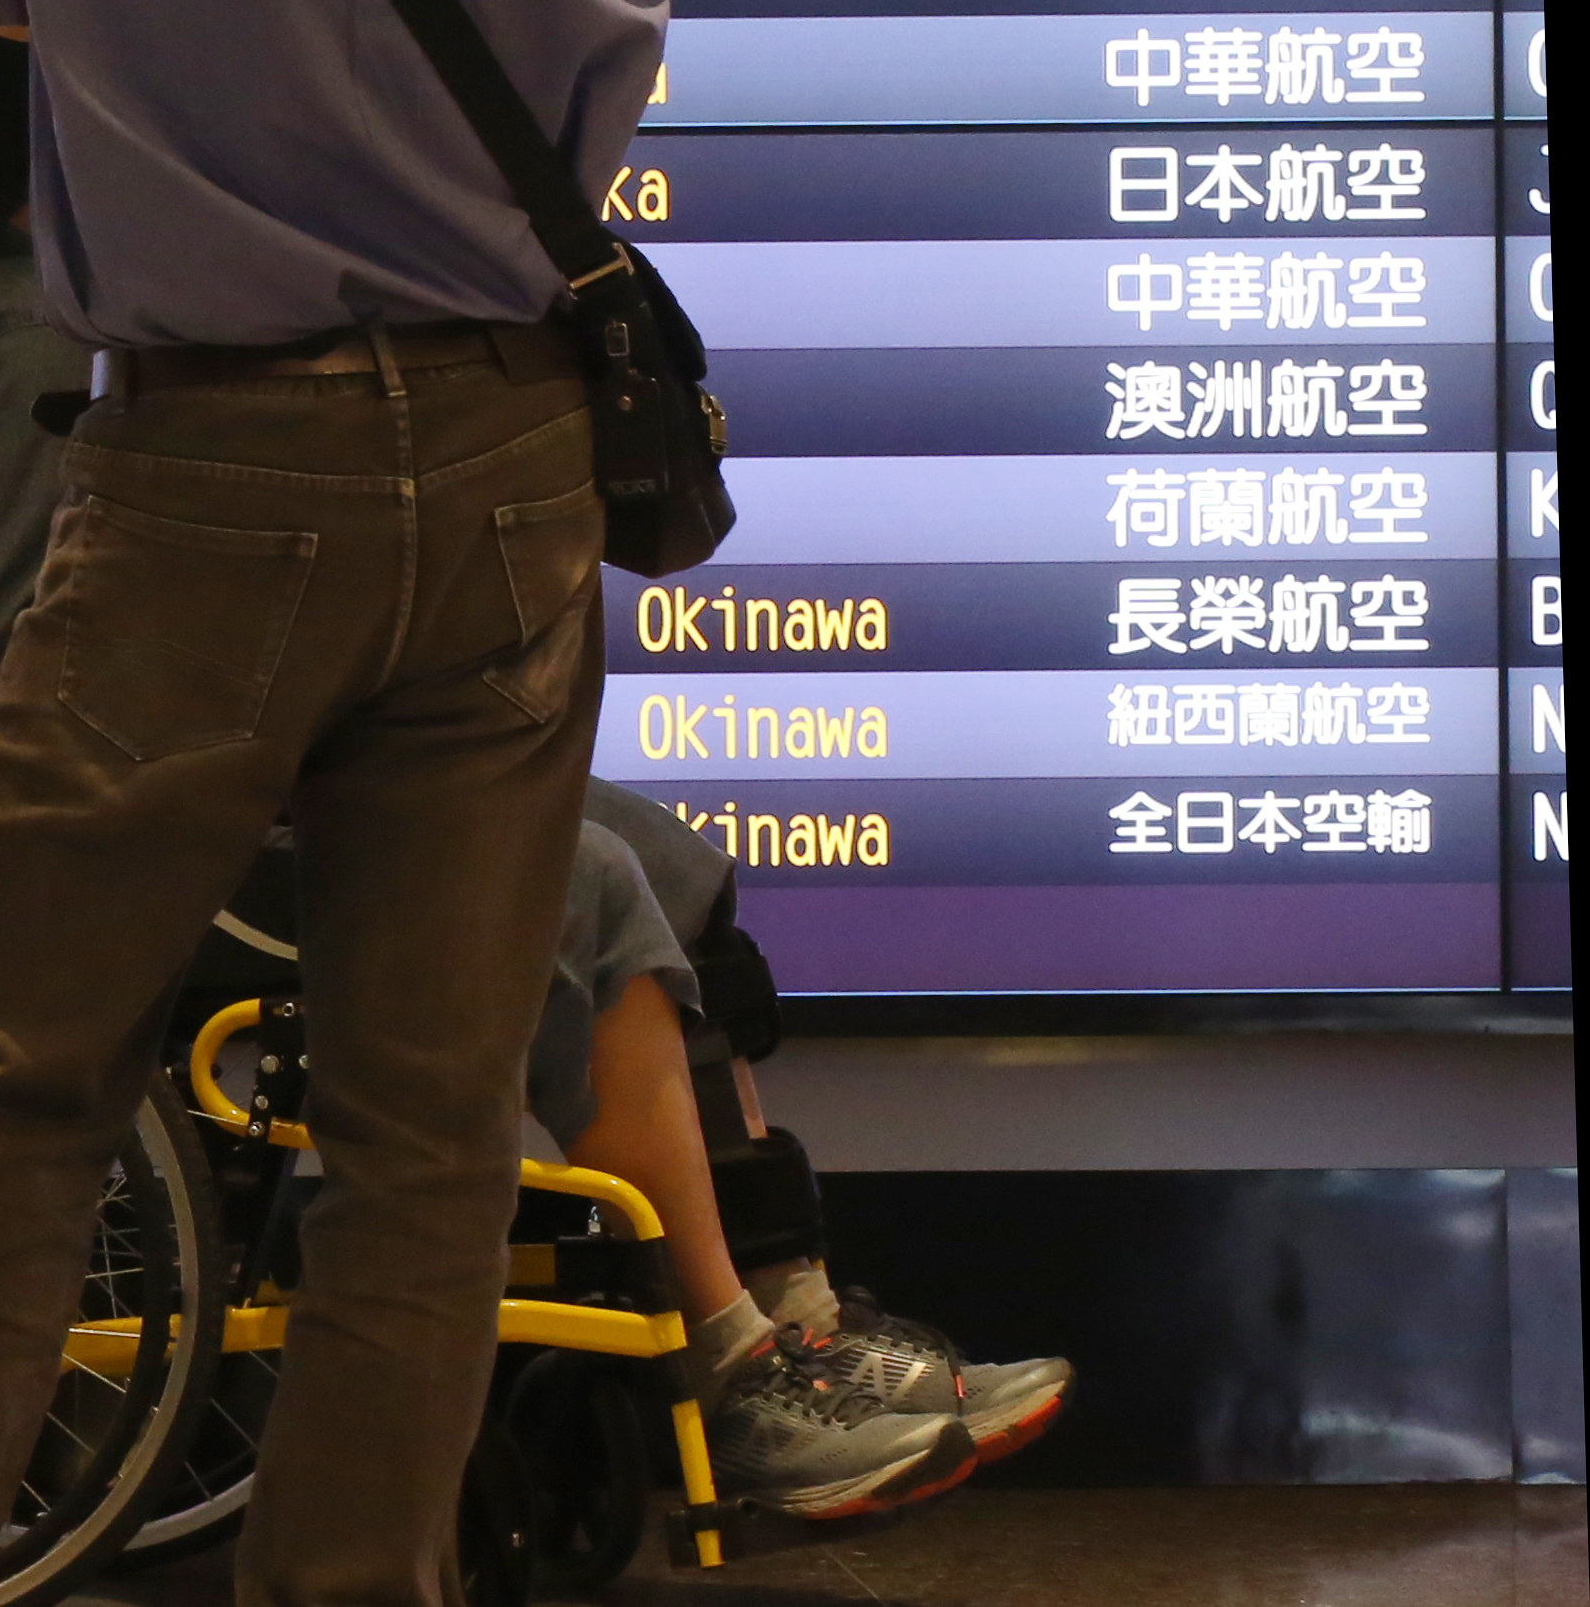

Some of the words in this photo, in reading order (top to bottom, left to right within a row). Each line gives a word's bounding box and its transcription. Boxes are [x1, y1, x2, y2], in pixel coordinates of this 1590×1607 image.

[1109, 142, 1427, 223] 日本航空
[1104, 358, 1428, 440] 澳洲航空
[1105, 465, 1429, 548] 荷蘭航空
[637, 585, 887, 653] Okinawa
[1107, 573, 1430, 655] 長榮航空
[638, 693, 888, 761] Okinawa
[1108, 788, 1432, 854] 全日本空輸
